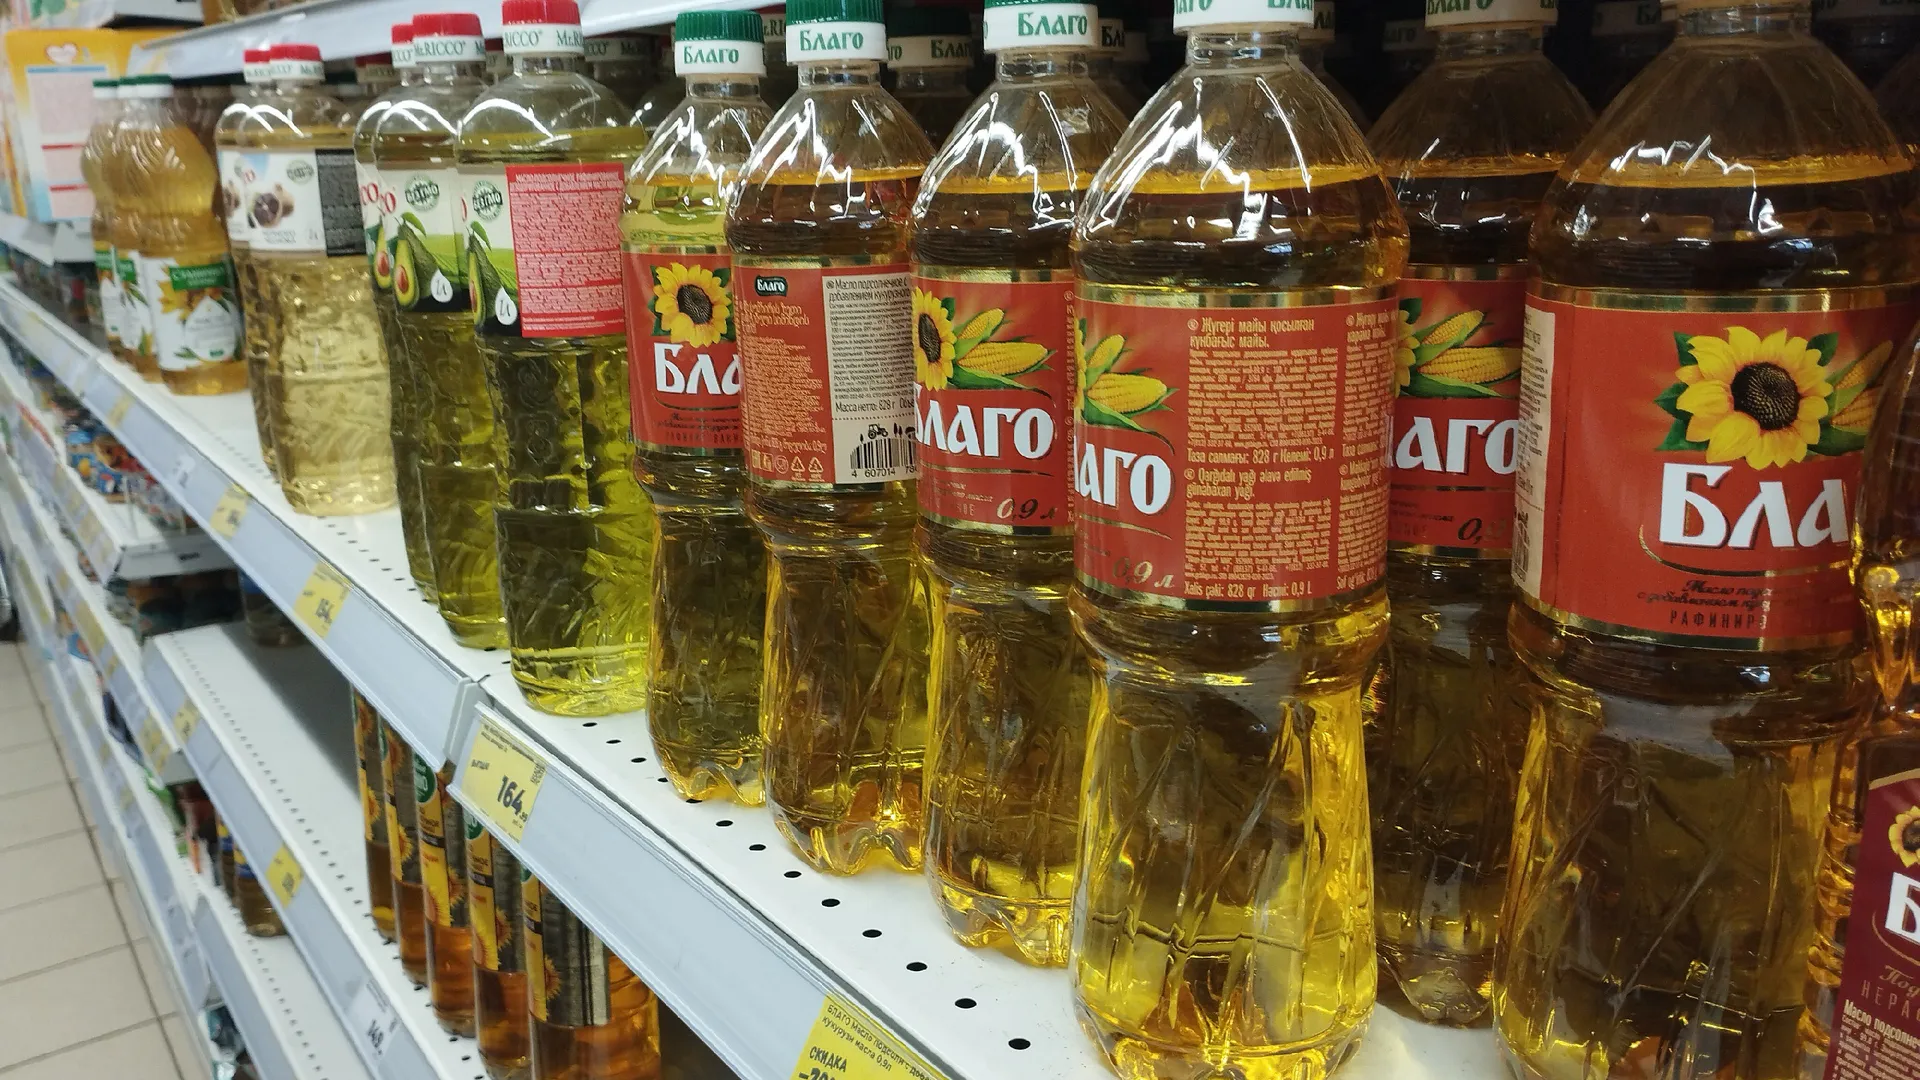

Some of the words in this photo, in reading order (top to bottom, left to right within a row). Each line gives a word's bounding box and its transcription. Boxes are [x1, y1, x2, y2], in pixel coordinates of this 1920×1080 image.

[800, 29, 864, 51] Благо
[1018, 12, 1087, 36] Благо
[683, 45, 740, 64] Благо
[1391, 416, 1519, 475] аго
[1074, 437, 1172, 515] аго
[497, 775, 526, 815] 164
[827, 1004, 851, 1026] БЛАГО
[851, 1023, 873, 1042] Масло
[809, 1046, 848, 1073] СКИДКА
